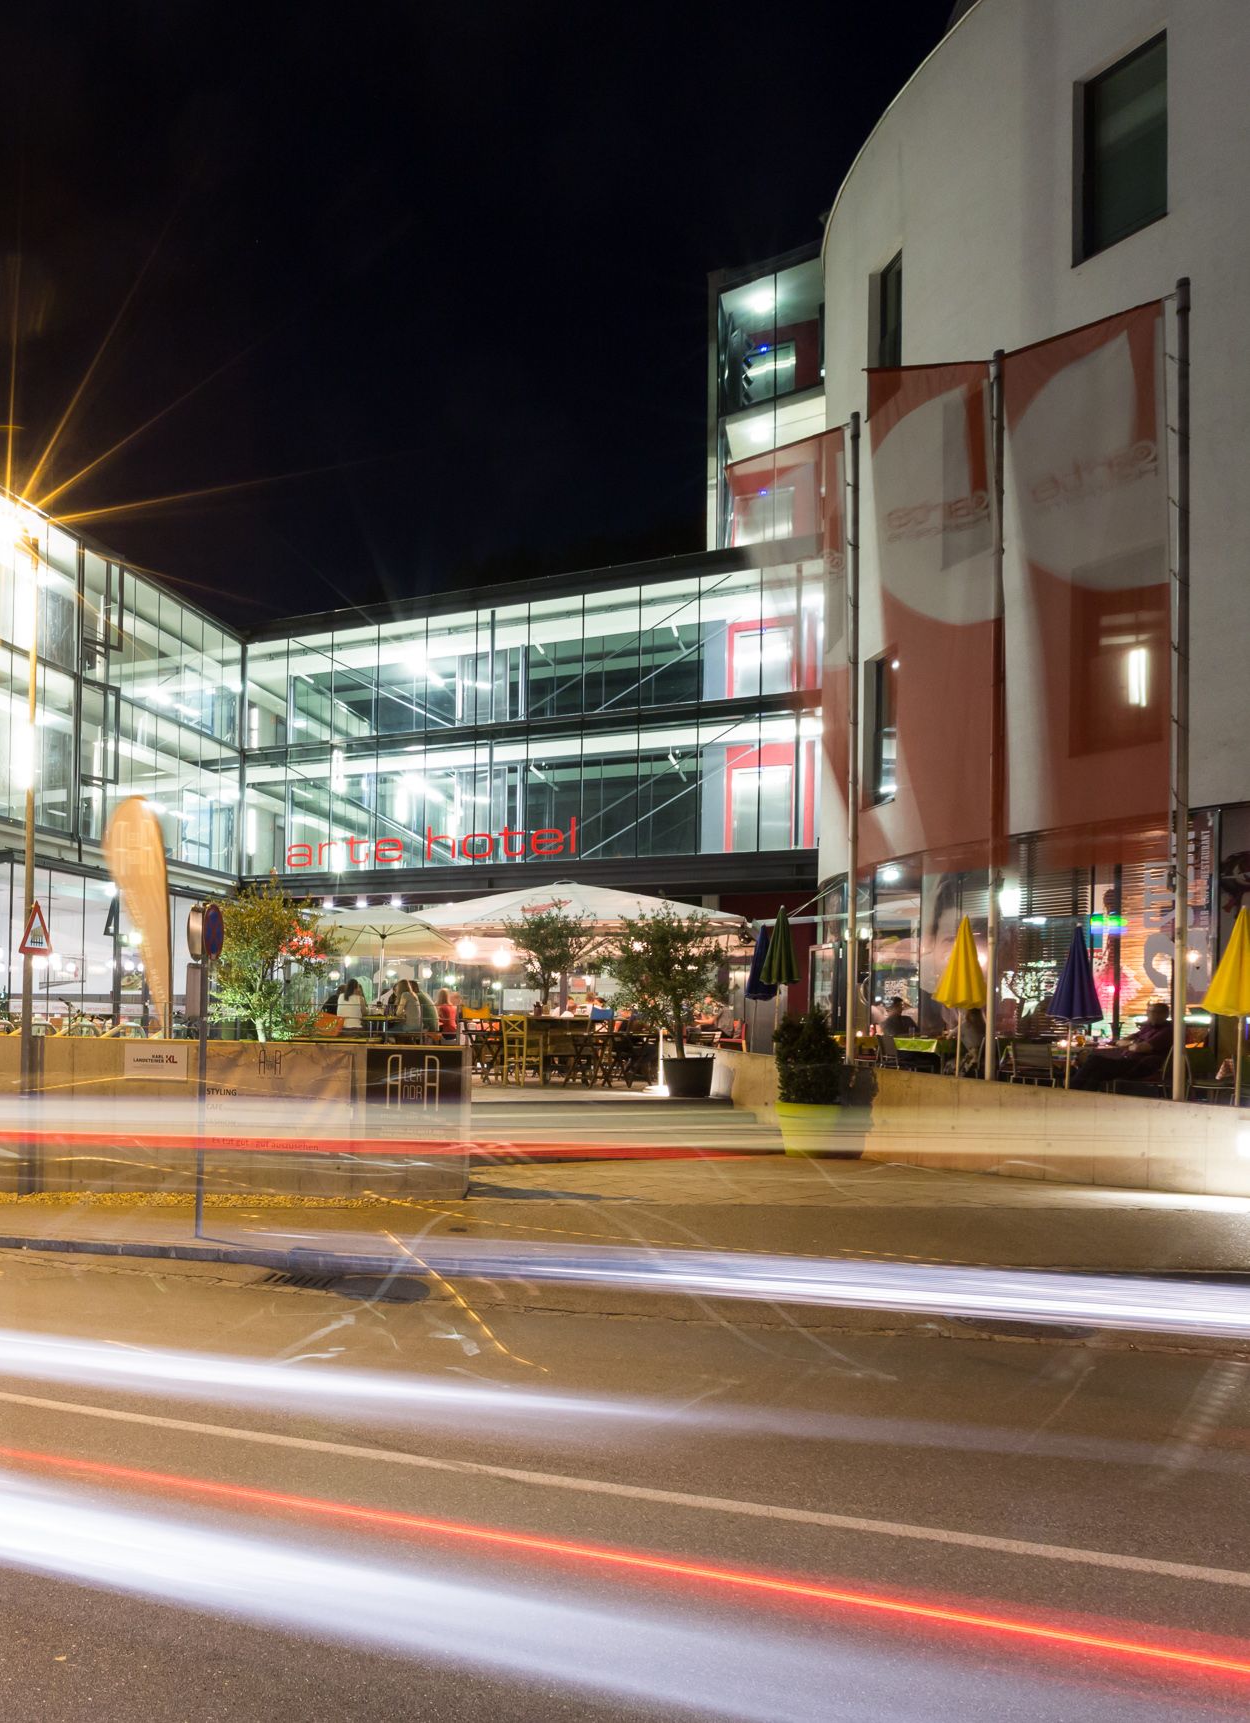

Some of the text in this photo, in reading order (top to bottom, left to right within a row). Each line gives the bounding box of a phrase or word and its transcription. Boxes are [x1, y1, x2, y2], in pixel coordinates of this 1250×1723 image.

[286, 817, 577, 868] arte hotel
[1200, 830, 1211, 879] RESTAURANT
[206, 1087, 238, 1097] STYLING
[222, 1137, 234, 1145] tut
[235, 1138, 249, 1147] gut
